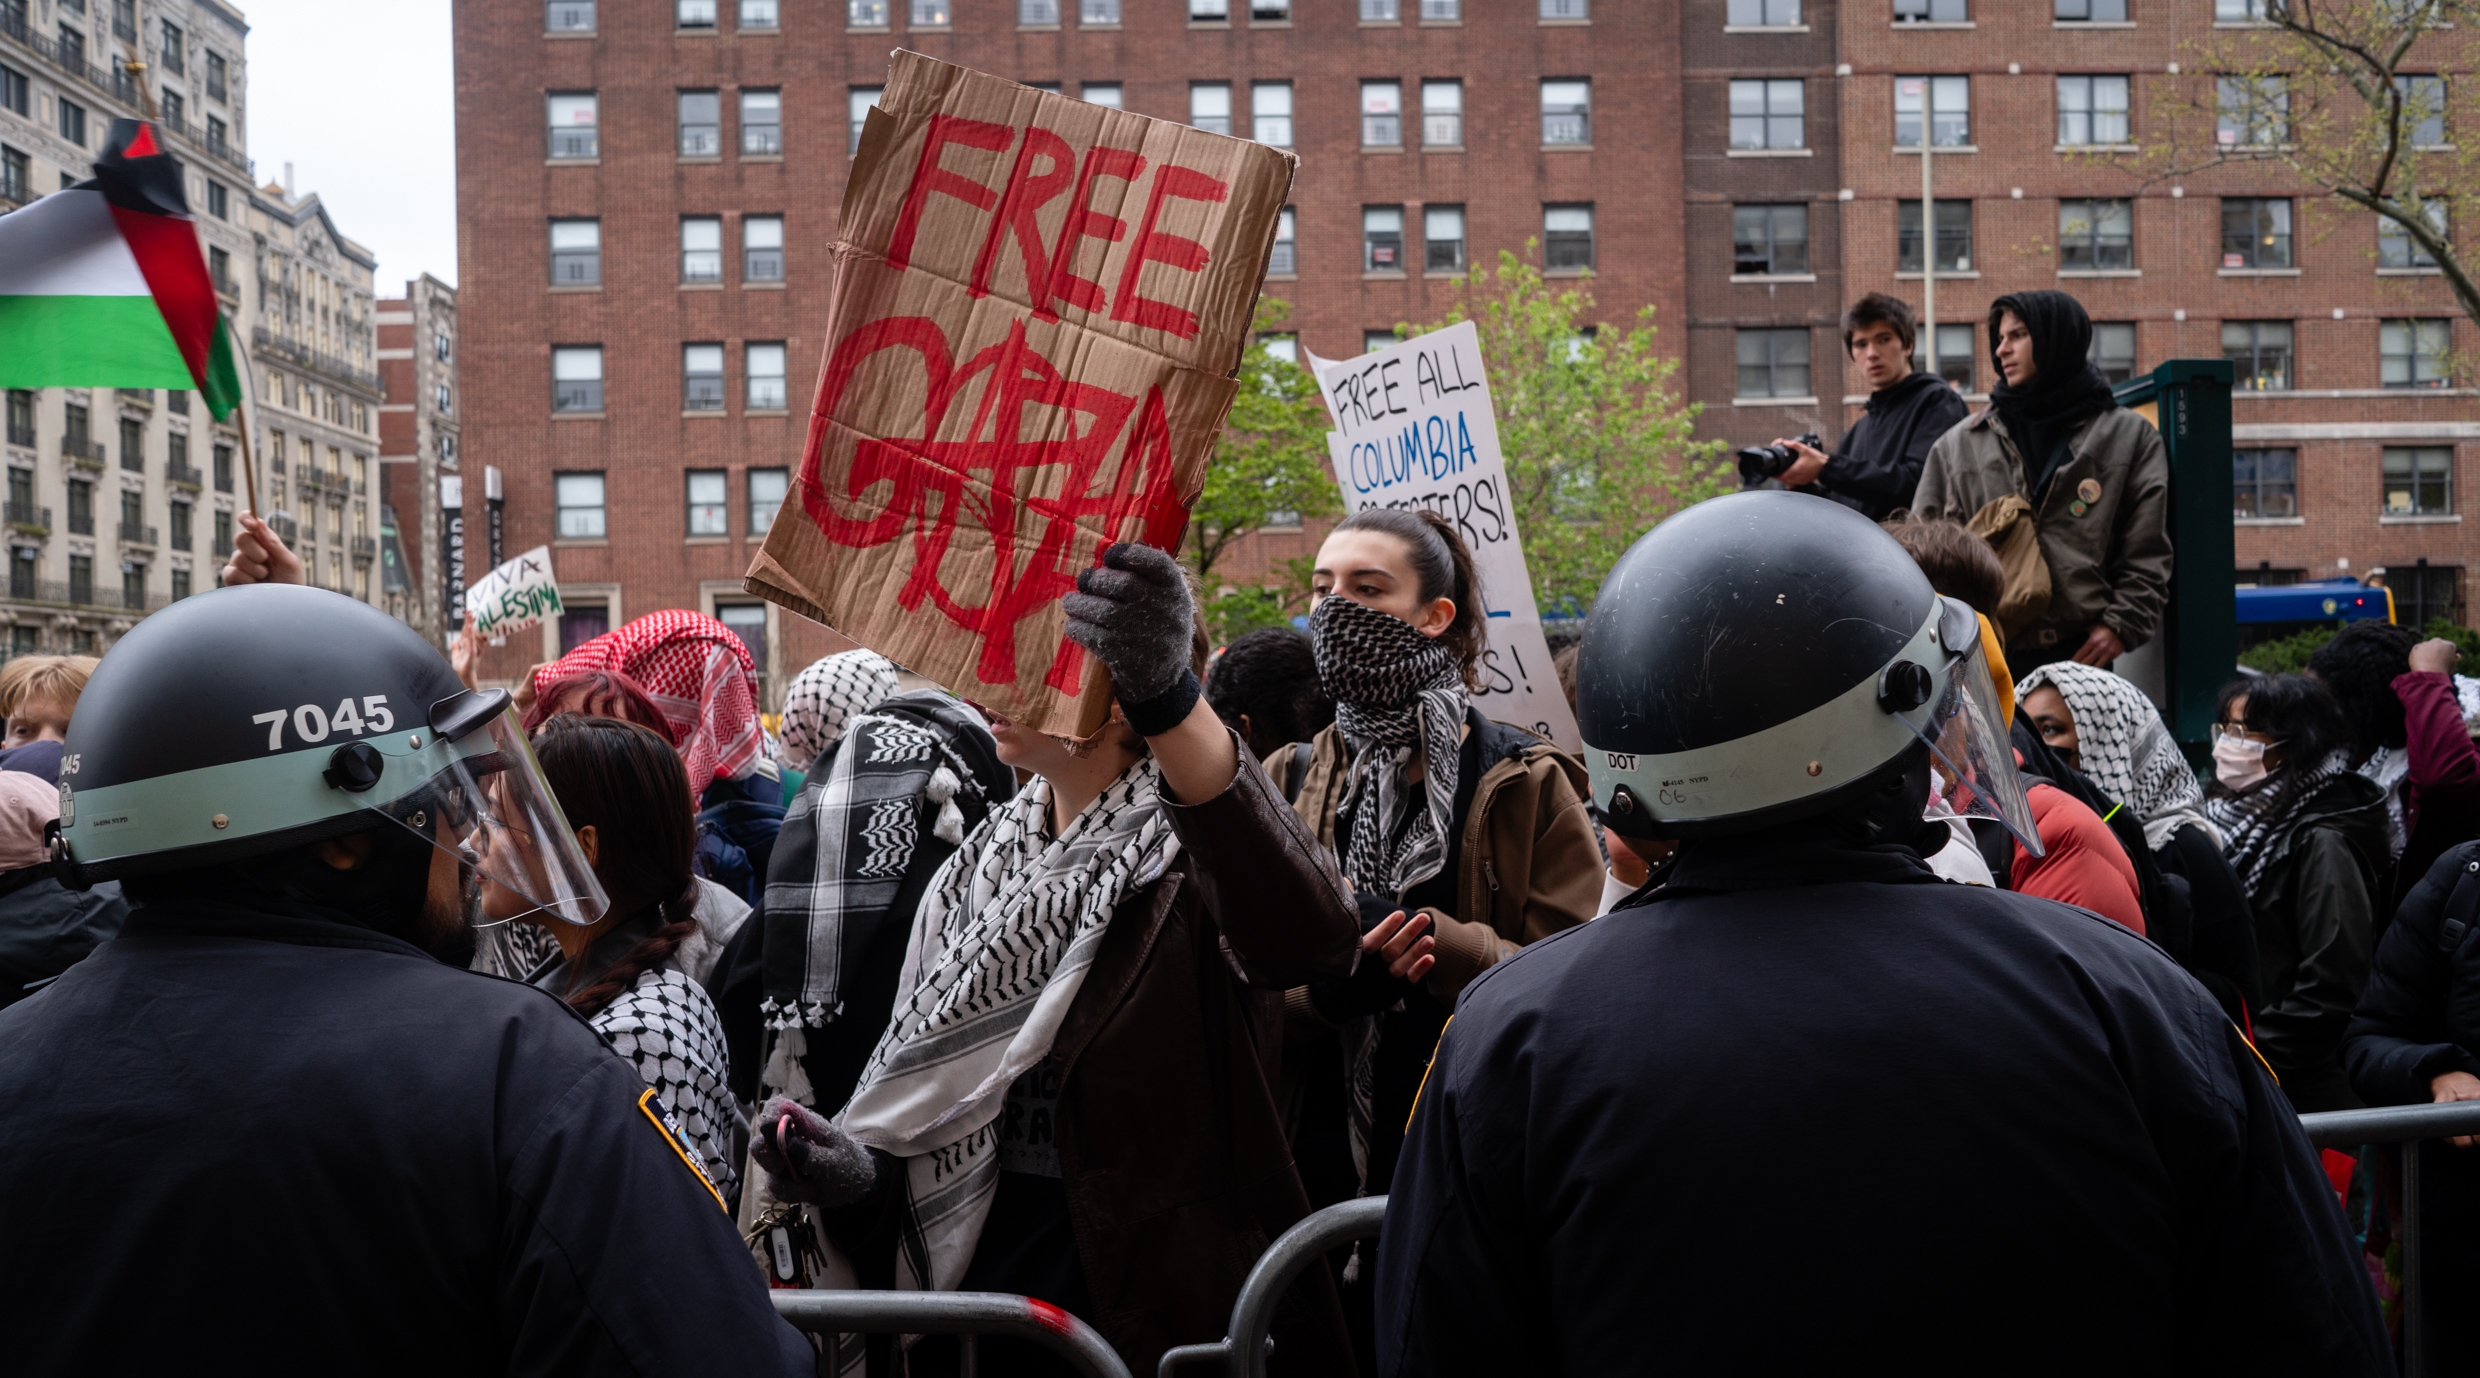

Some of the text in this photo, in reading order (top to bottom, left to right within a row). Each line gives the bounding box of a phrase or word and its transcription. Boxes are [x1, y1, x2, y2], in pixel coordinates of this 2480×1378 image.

[886, 114, 1229, 341] FREE
[1332, 344, 1480, 437] FREE ALL
[1350, 411, 1477, 494] COLUMBIA
[472, 558, 543, 604] VIVA
[474, 581, 562, 633] ALESTINA
[252, 694, 395, 751] 7045
[61, 753, 81, 776] 045
[1607, 753, 1636, 770] DOT
[1689, 776, 1709, 784] NYPD
